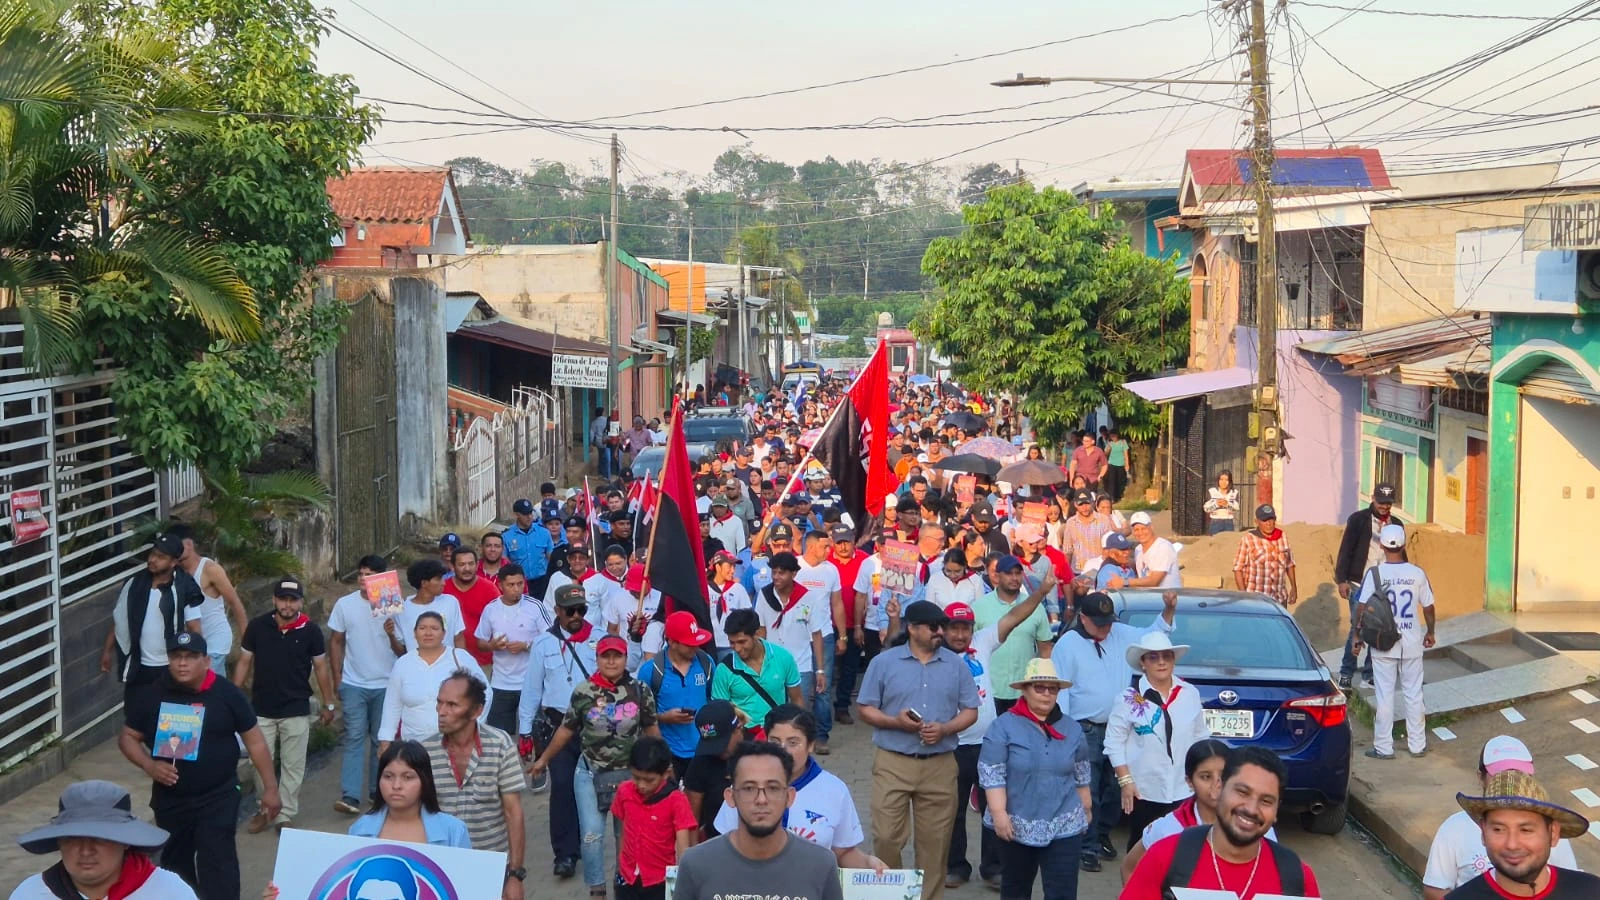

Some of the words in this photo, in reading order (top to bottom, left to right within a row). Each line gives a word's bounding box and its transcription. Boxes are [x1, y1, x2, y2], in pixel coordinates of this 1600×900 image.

[554, 355, 578, 365] Oficina
[579, 357, 587, 365] de
[564, 365, 583, 375] Roberto
[1221, 717, 1250, 730] 36235
